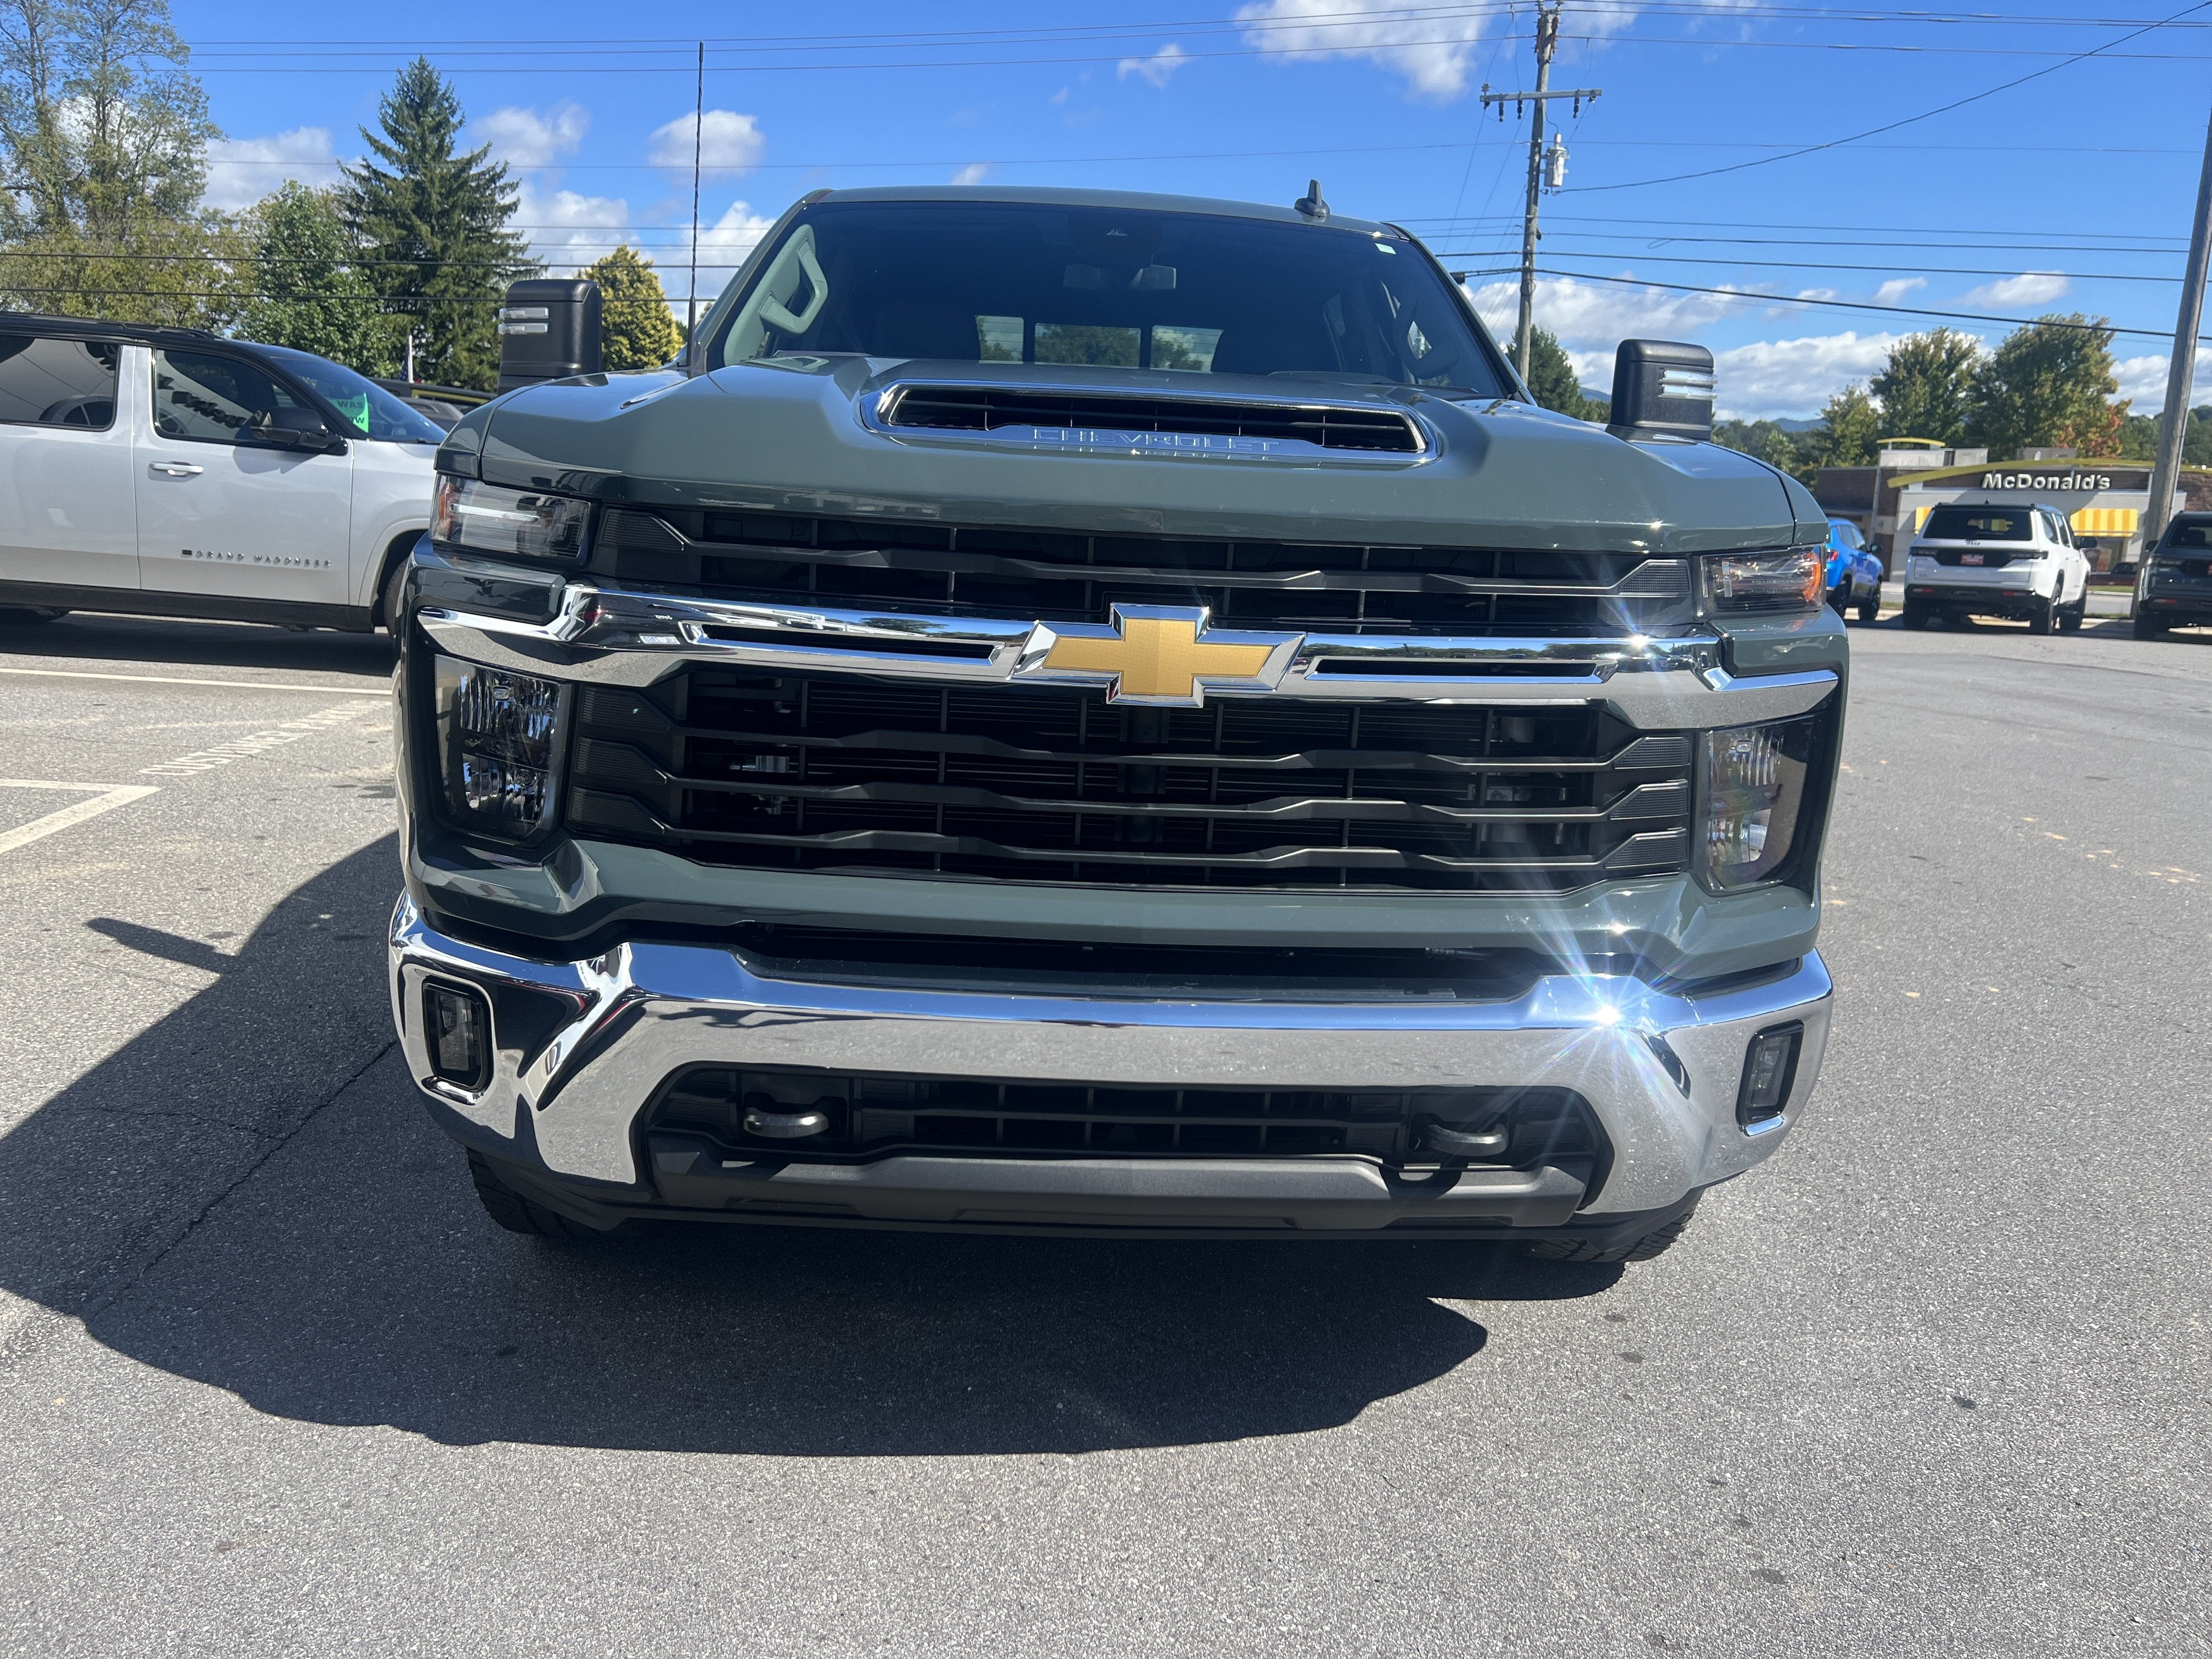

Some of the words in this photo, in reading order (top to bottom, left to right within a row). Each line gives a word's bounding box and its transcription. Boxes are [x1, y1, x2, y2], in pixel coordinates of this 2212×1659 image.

[1034, 427, 1279, 452] CHEVROLET
[1981, 473, 2111, 490] McDonald's
[196, 550, 244, 561] GRAND
